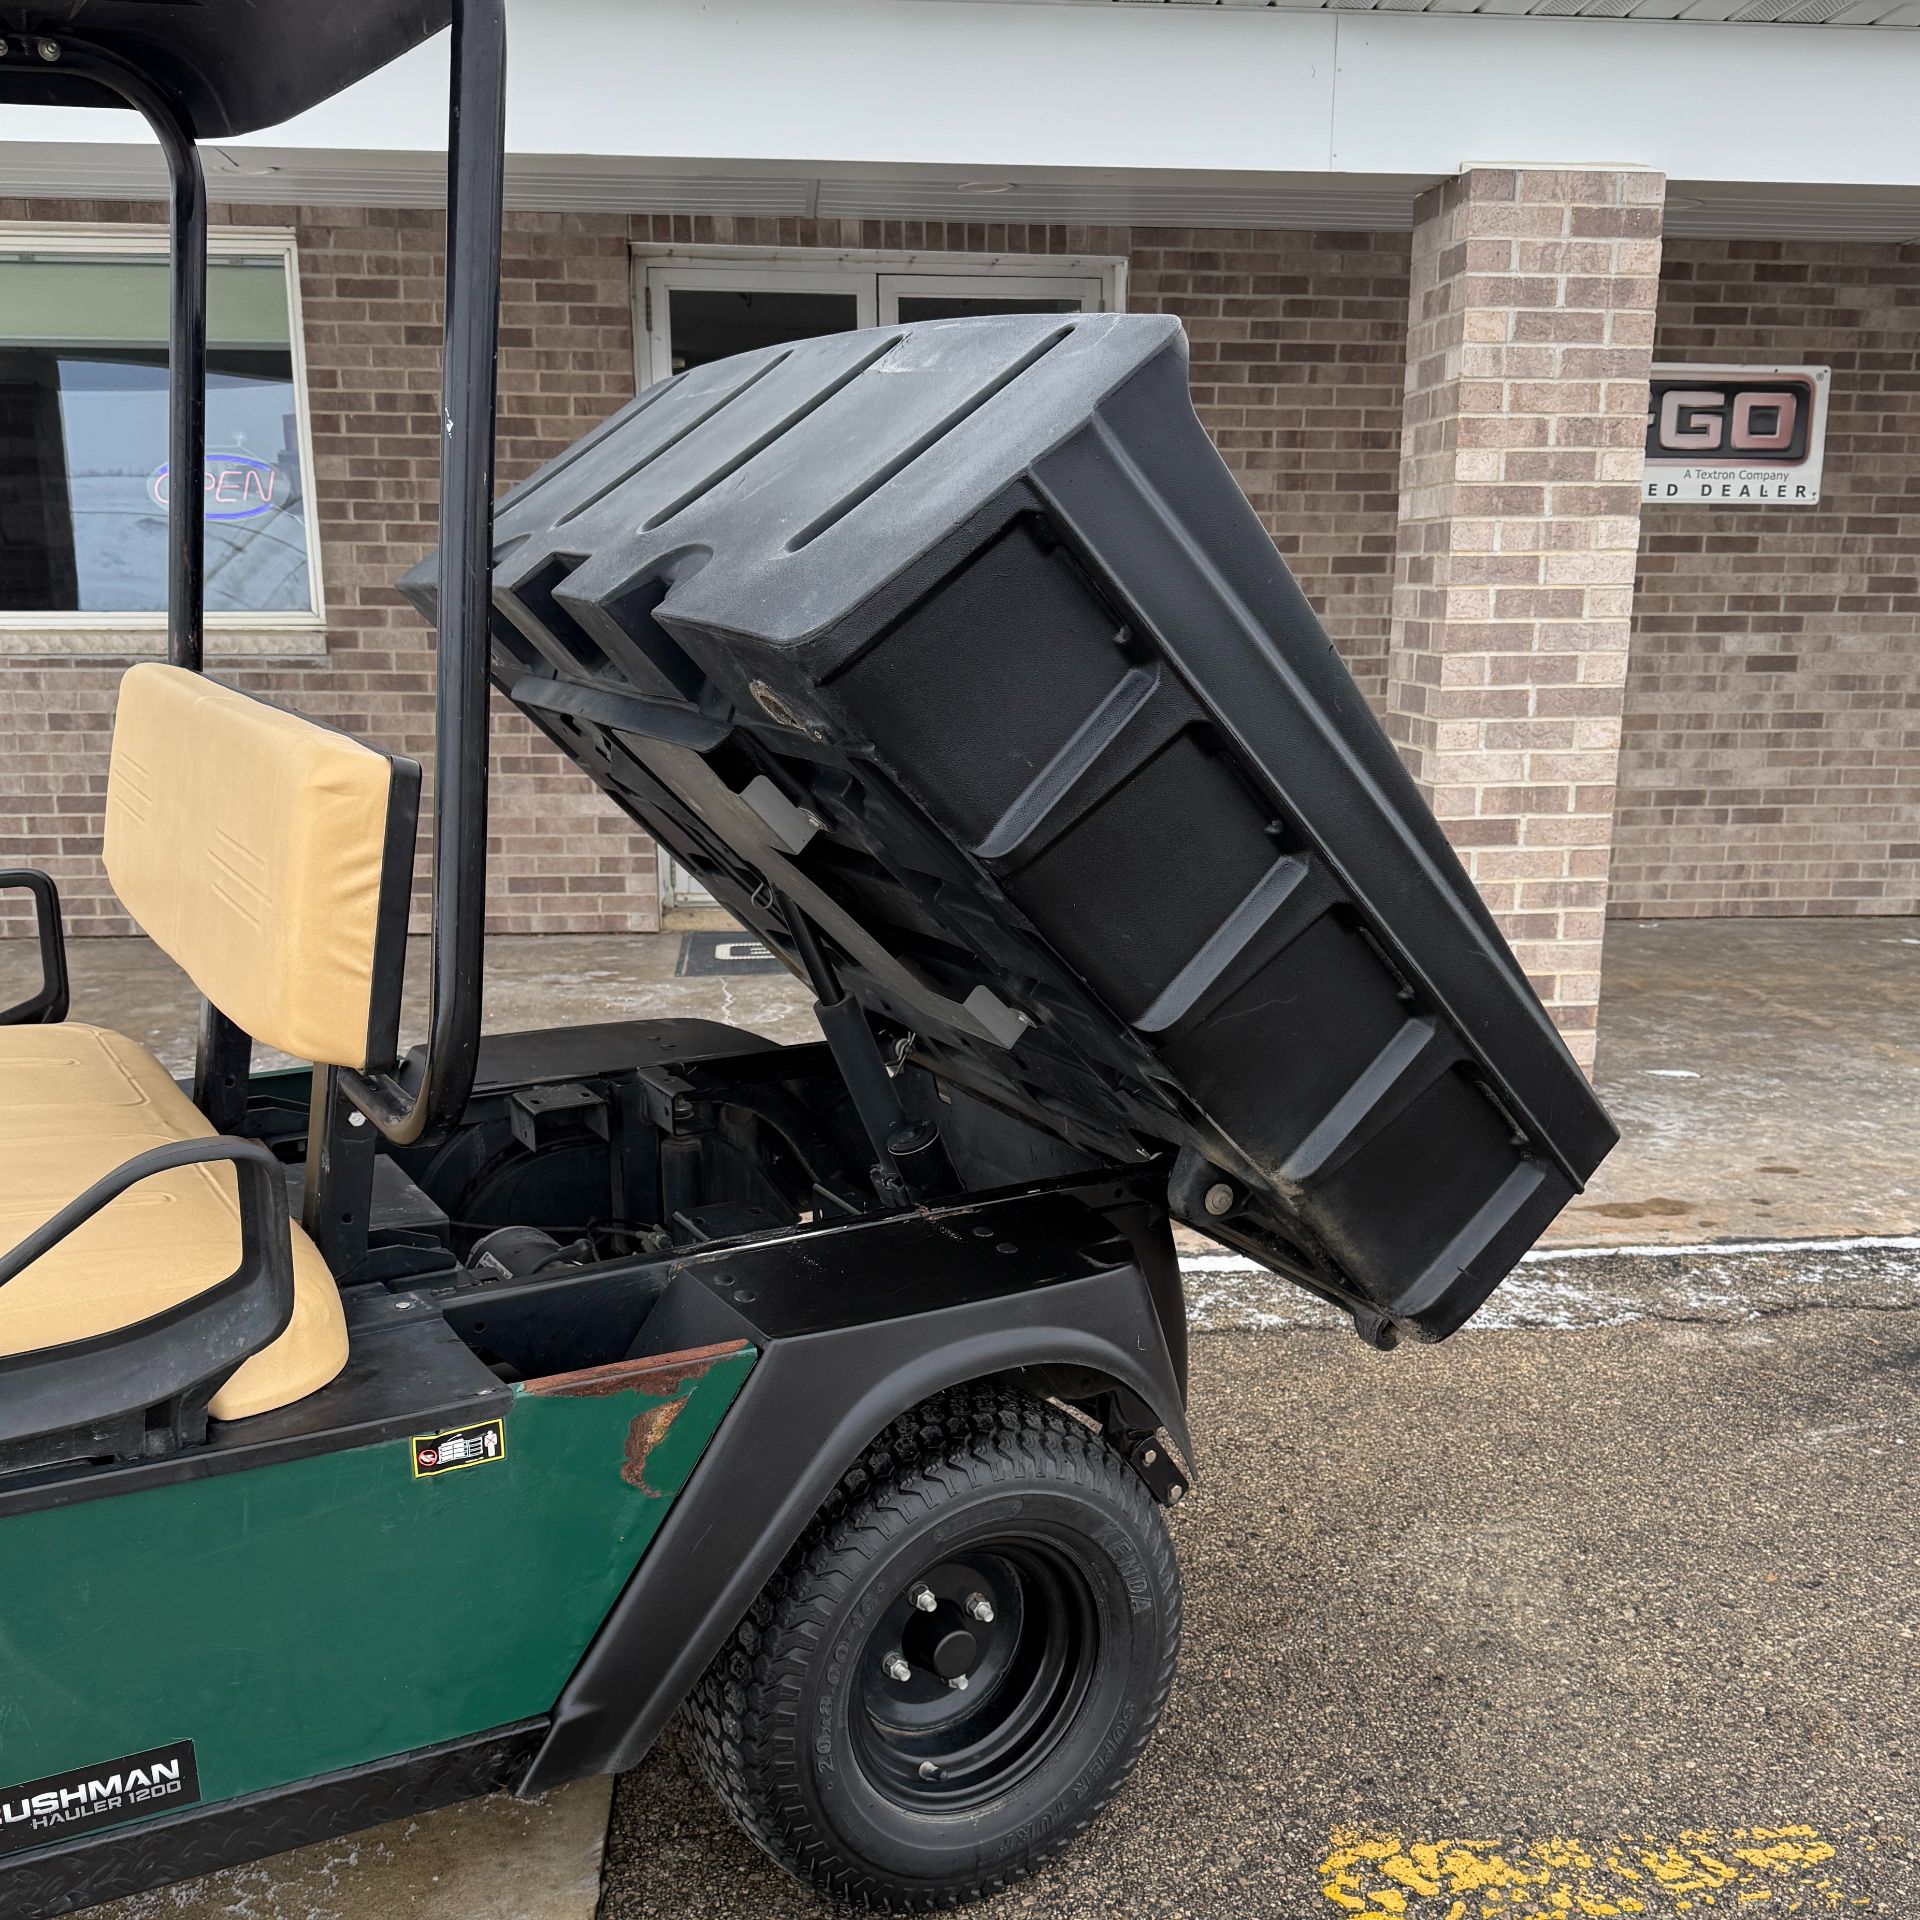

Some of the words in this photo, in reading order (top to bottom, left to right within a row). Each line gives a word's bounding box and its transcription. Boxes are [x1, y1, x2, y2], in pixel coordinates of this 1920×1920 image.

[1648, 391, 1797, 449] GO
[1684, 470, 1692, 479] A
[1695, 469, 1735, 480] Textron
[1739, 470, 1789, 482] Company
[1701, 484, 1806, 498] DEALER
[1089, 1520, 1153, 1615] KENDA
[1072, 1701, 1136, 1800] SUPER
[0, 1759, 180, 1824] USHMAN
[32, 1795, 122, 1830] HAULER
[129, 1779, 182, 1804] 1200
